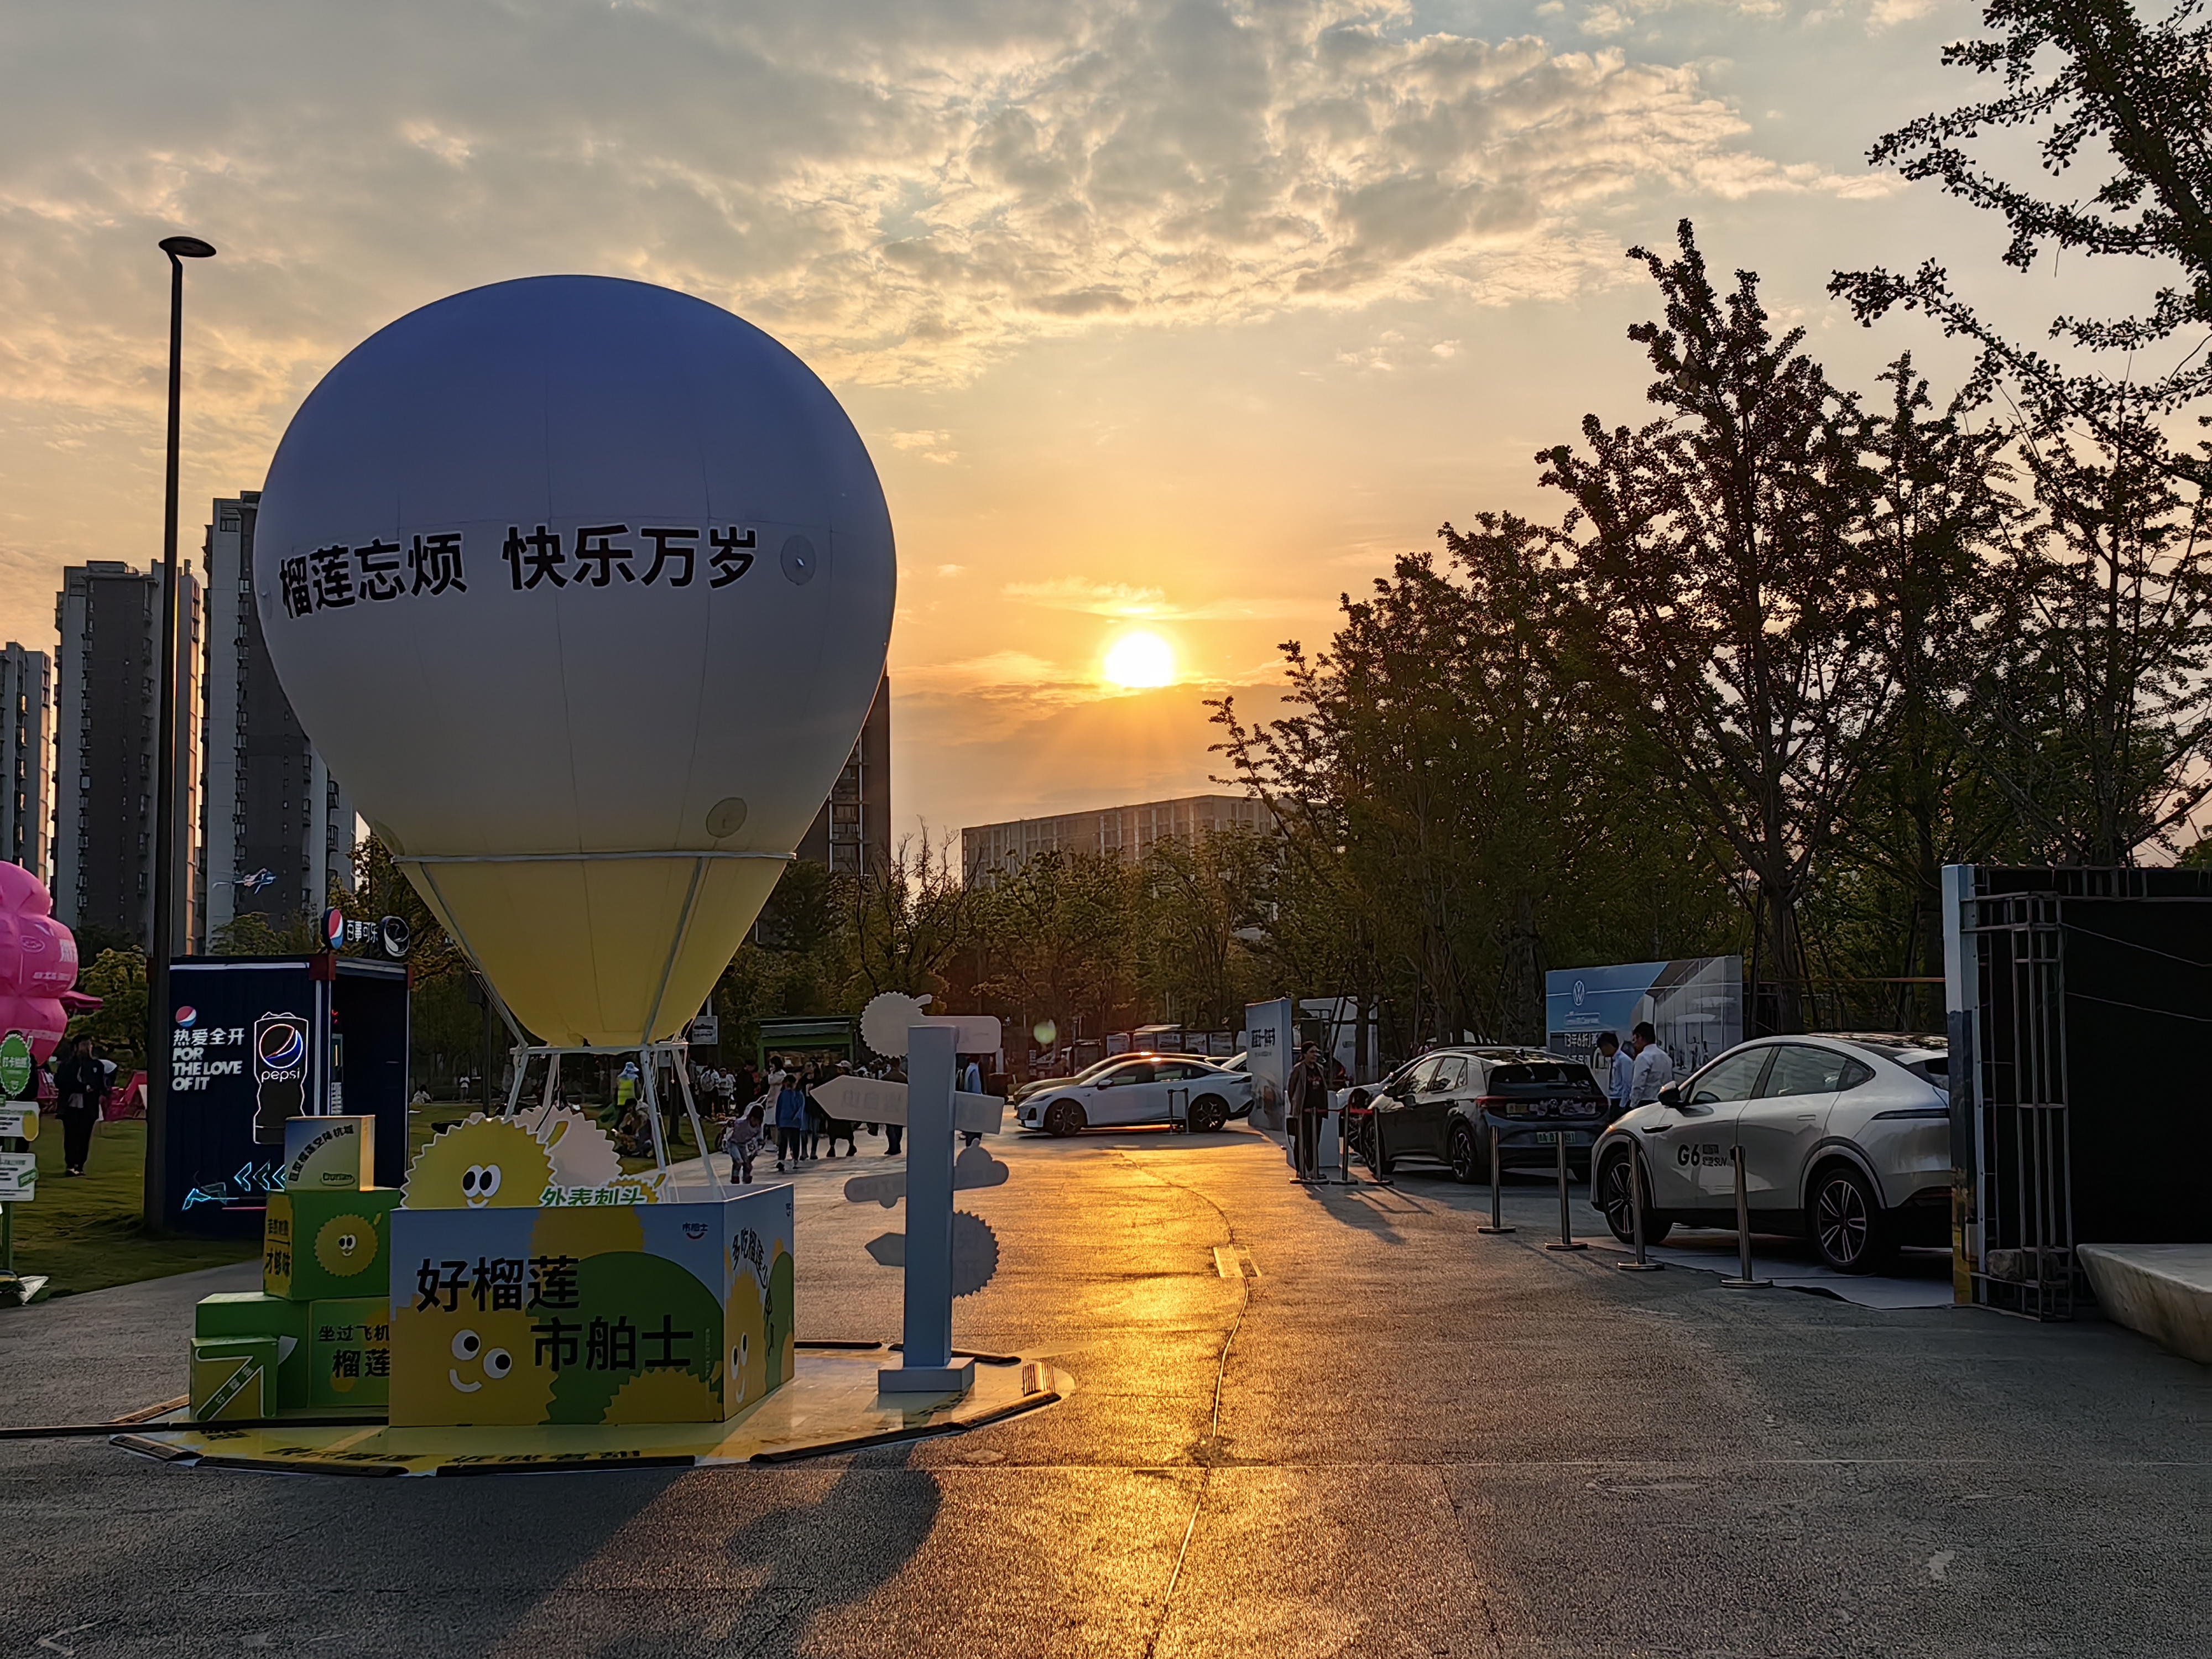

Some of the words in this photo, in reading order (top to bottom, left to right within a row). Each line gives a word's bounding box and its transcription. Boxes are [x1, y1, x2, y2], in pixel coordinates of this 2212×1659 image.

[279, 533, 467, 619] 榴莲忘烦
[502, 524, 757, 591] 快乐万岁
[173, 1028, 245, 1047] 热爱全开
[173, 1047, 203, 1061] FOR
[173, 1062, 201, 1076] THE
[202, 1061, 242, 1075] LOVE
[261, 1068, 300, 1083] pepsi
[172, 1076, 195, 1091] OF
[195, 1076, 210, 1089] IT
[1678, 1144, 1700, 1166] G6
[542, 1188, 644, 1206] 外表刺头
[416, 1255, 579, 1312] 好榴莲
[318, 1325, 389, 1342] 坐过飞机
[530, 1314, 693, 1372] 市舶士
[332, 1349, 389, 1378] 榴莲
